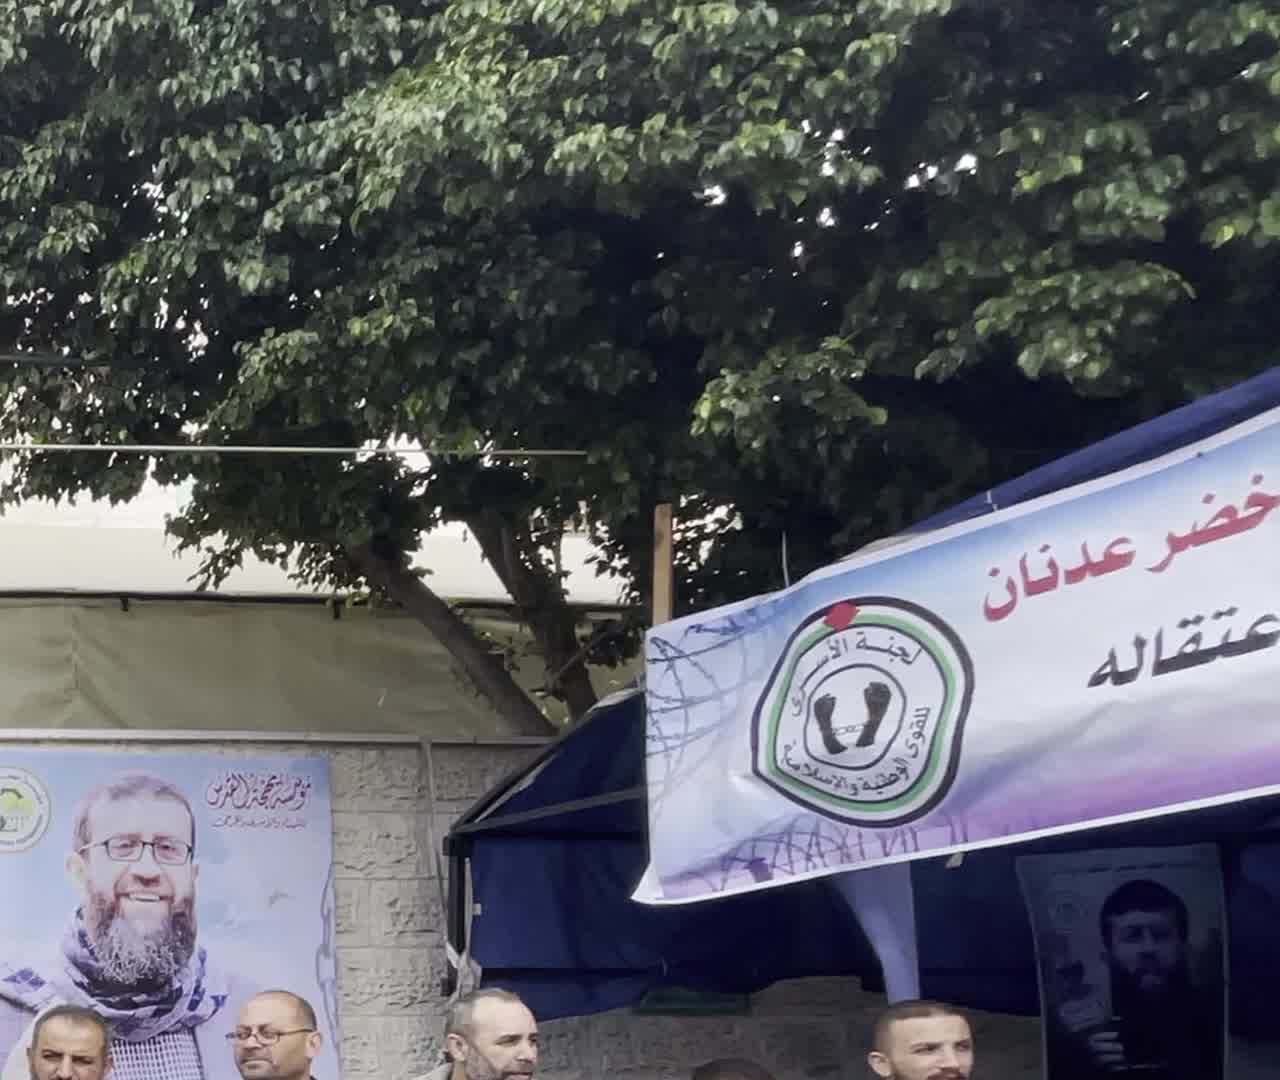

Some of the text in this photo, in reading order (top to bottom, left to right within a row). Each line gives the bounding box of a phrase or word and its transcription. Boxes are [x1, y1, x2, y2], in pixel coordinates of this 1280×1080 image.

[984, 474, 1280, 622] خضر عدنان
[855, 631, 922, 666] لجنة
